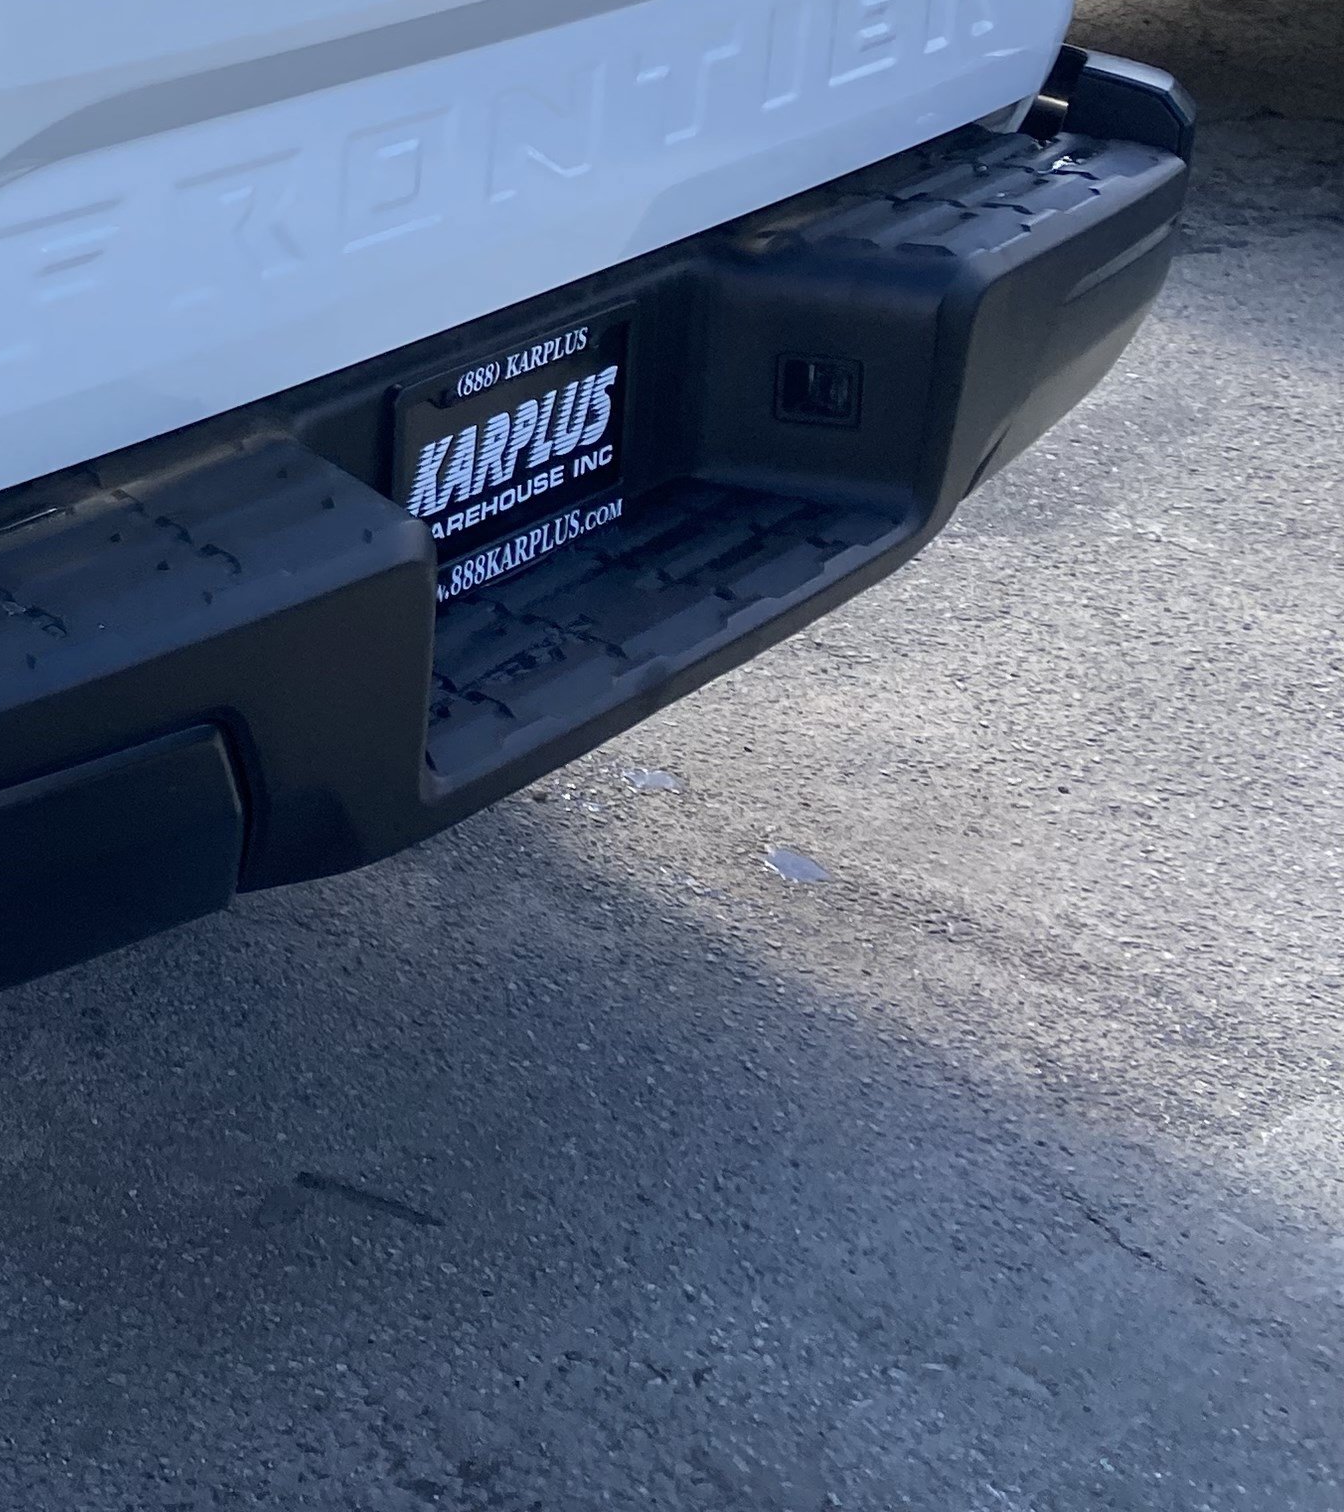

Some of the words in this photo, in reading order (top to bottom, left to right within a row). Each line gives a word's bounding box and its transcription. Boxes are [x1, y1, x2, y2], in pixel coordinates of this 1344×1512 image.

[457, 361, 501, 398] (888)
[505, 326, 590, 381] KARPLUS
[406, 364, 619, 518] KARPLUS
[431, 465, 565, 540] AREHOUSE
[573, 444, 614, 478] INC
